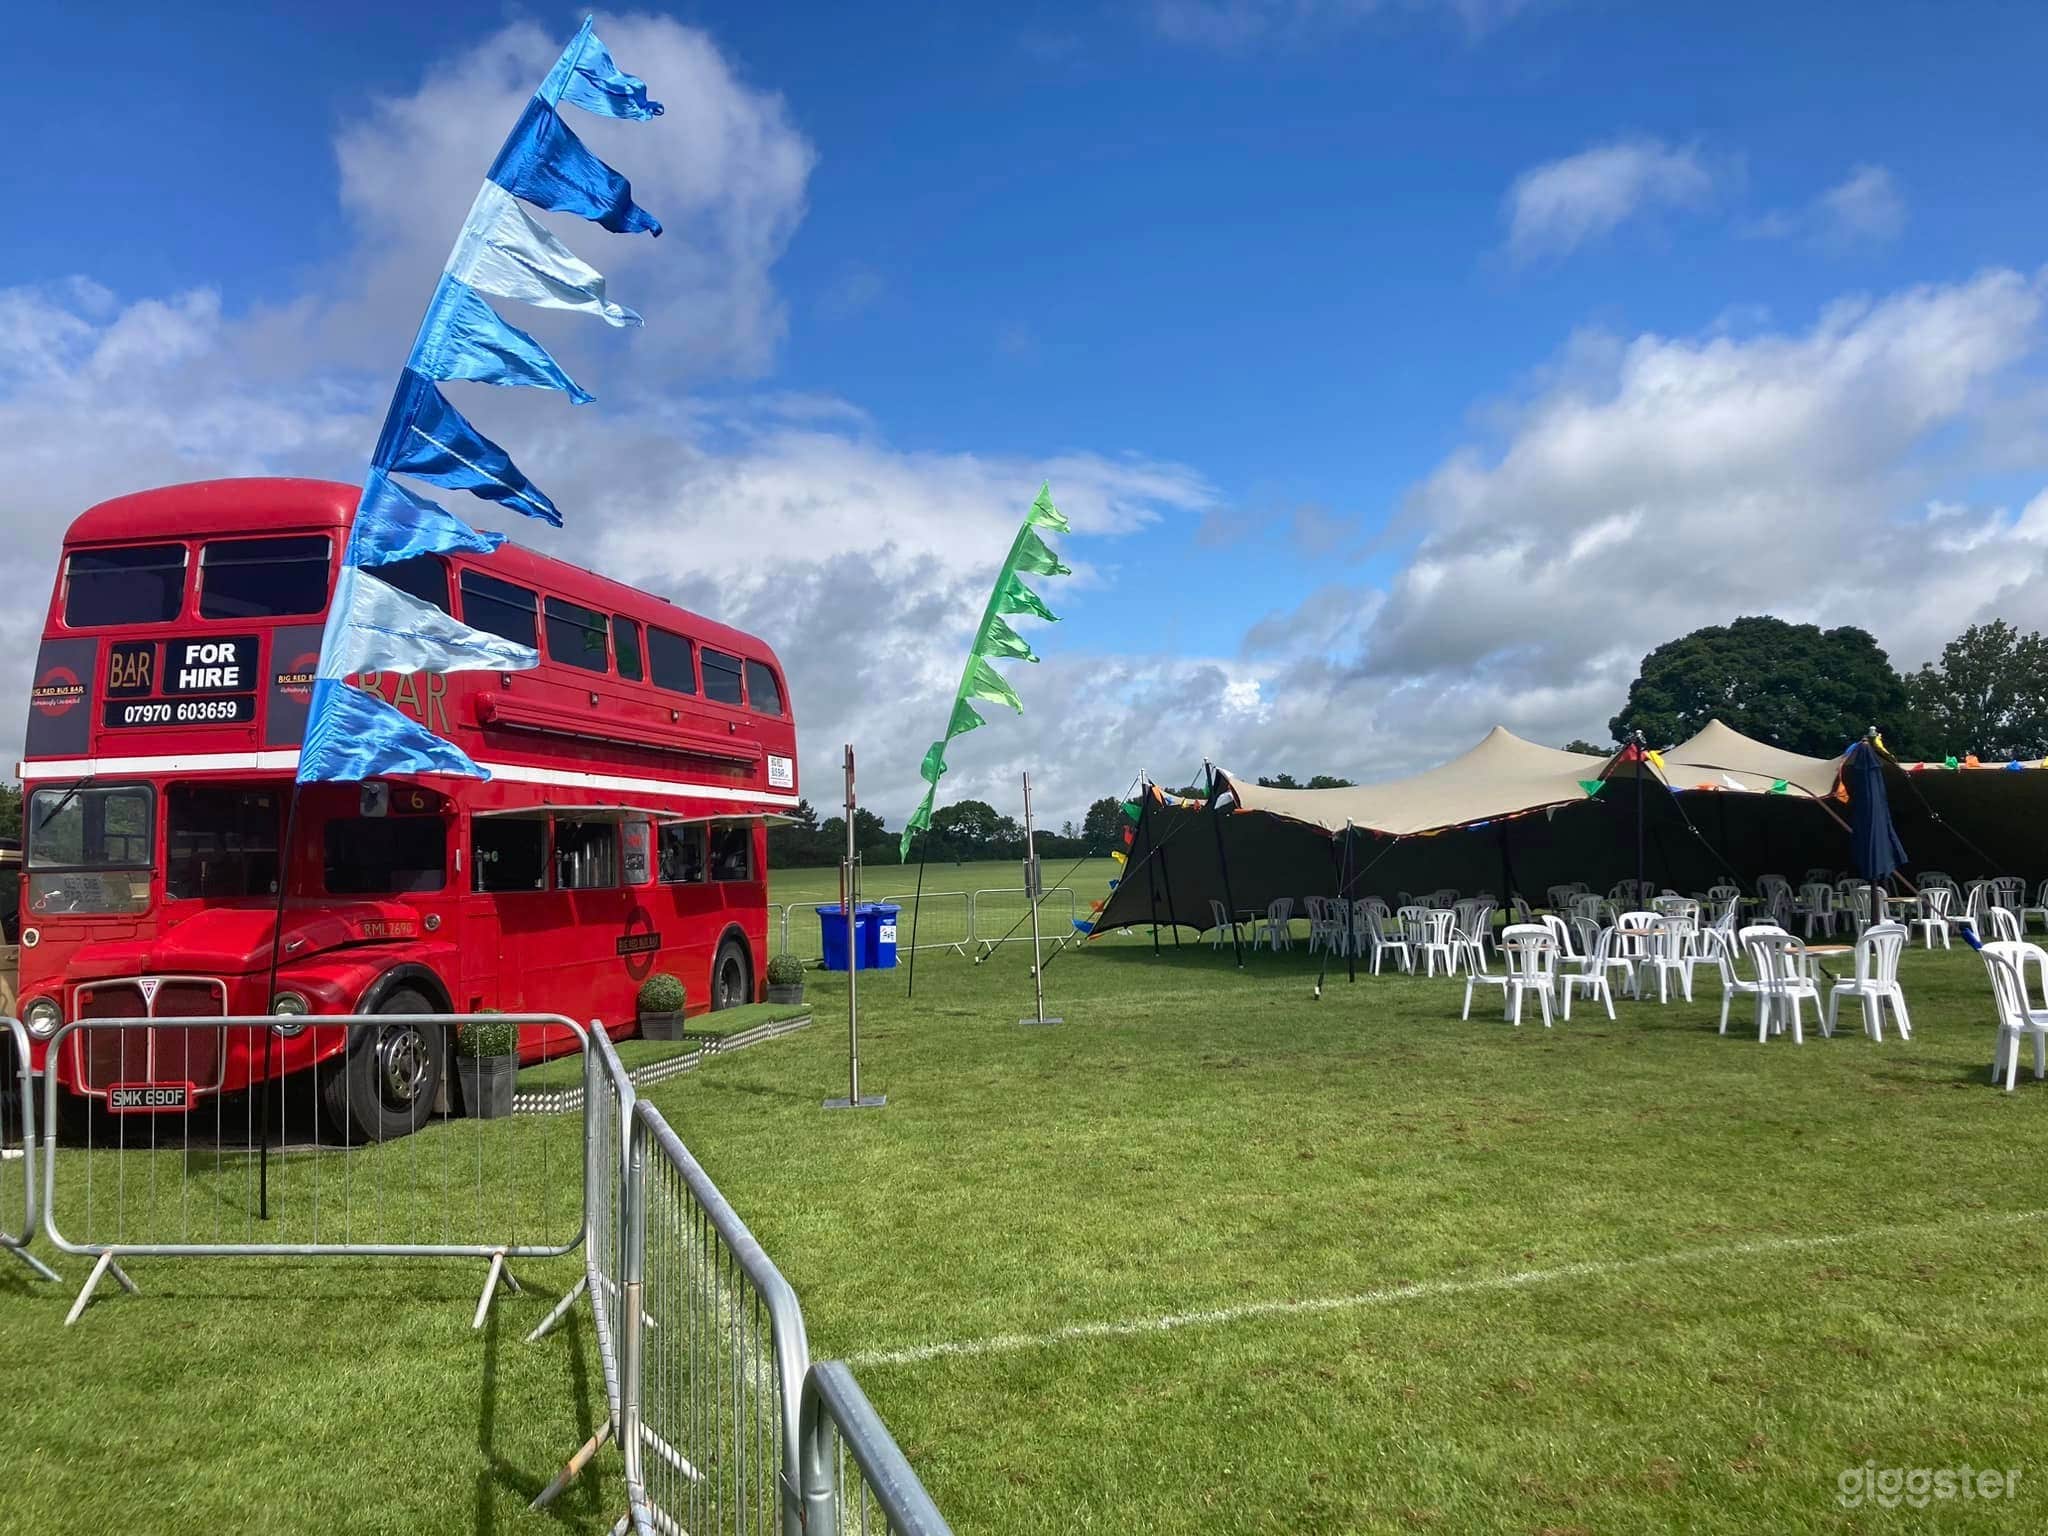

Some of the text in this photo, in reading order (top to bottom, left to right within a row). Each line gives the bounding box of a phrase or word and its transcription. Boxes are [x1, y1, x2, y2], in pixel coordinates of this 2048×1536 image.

[185, 643, 236, 665] FOR
[109, 651, 151, 688] BAR
[178, 666, 240, 689] HIRE
[124, 700, 237, 723] 07970 603659
[410, 791, 425, 809] 6
[112, 1089, 185, 1106] SMK 690F
